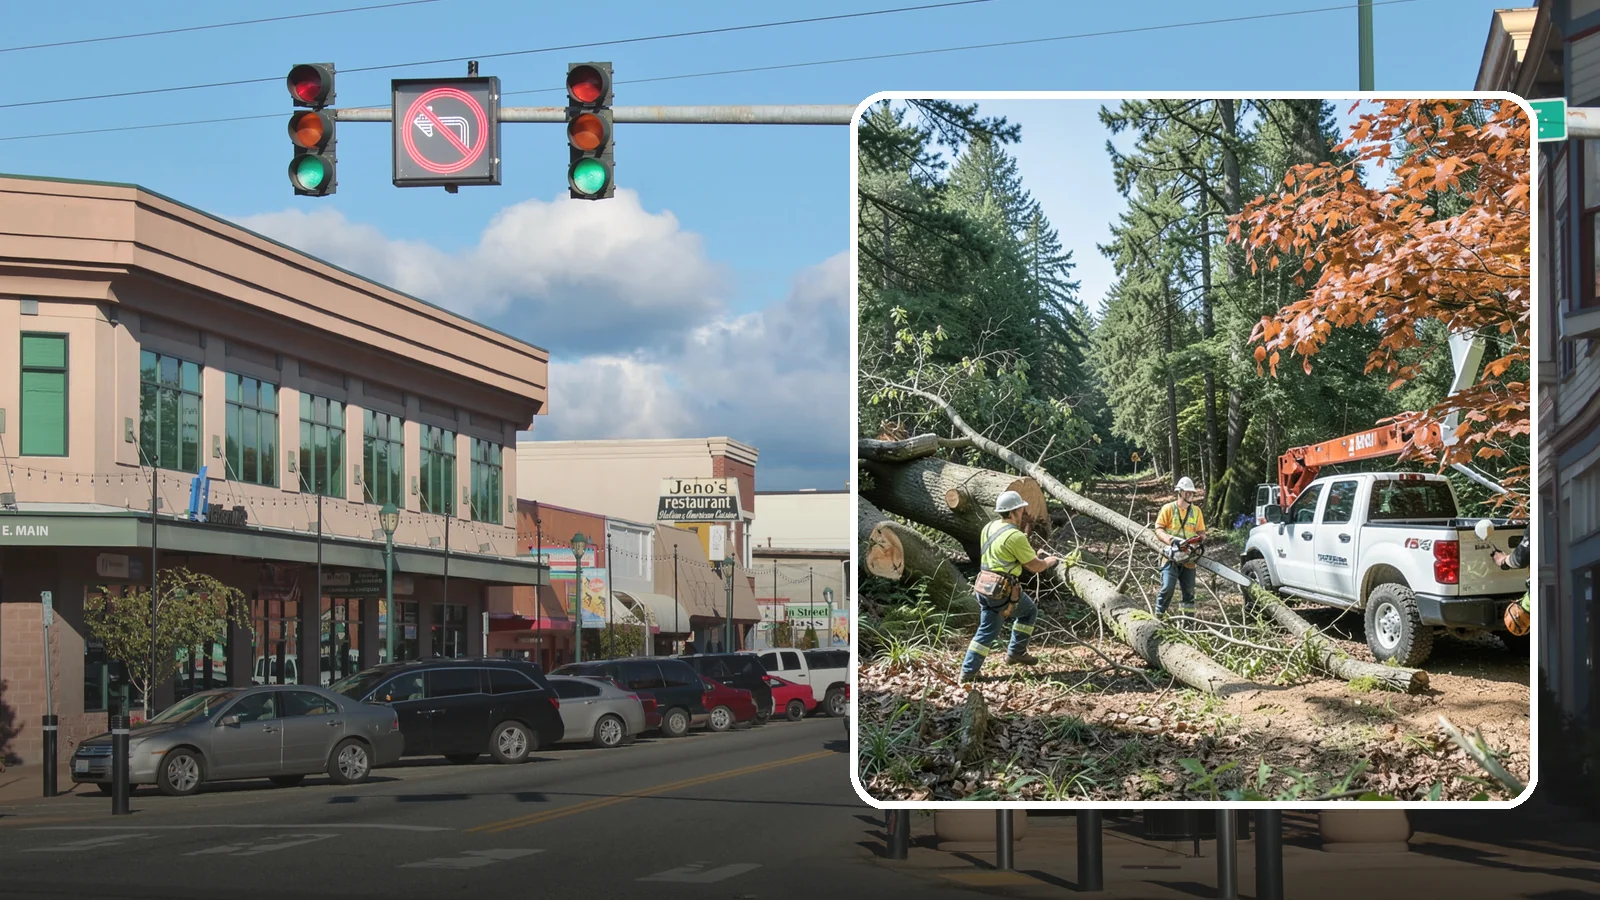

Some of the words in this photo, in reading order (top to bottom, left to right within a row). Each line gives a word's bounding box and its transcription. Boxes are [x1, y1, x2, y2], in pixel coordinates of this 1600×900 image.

[670, 480, 727, 494] Jeno's
[665, 496, 731, 509] restaurant
[658, 510, 682, 519] Italian
[686, 510, 714, 519] American
[715, 510, 738, 519] Cuisine
[2, 525, 13, 536] E.
[15, 525, 49, 536] MAIN
[797, 607, 828, 616] Street
